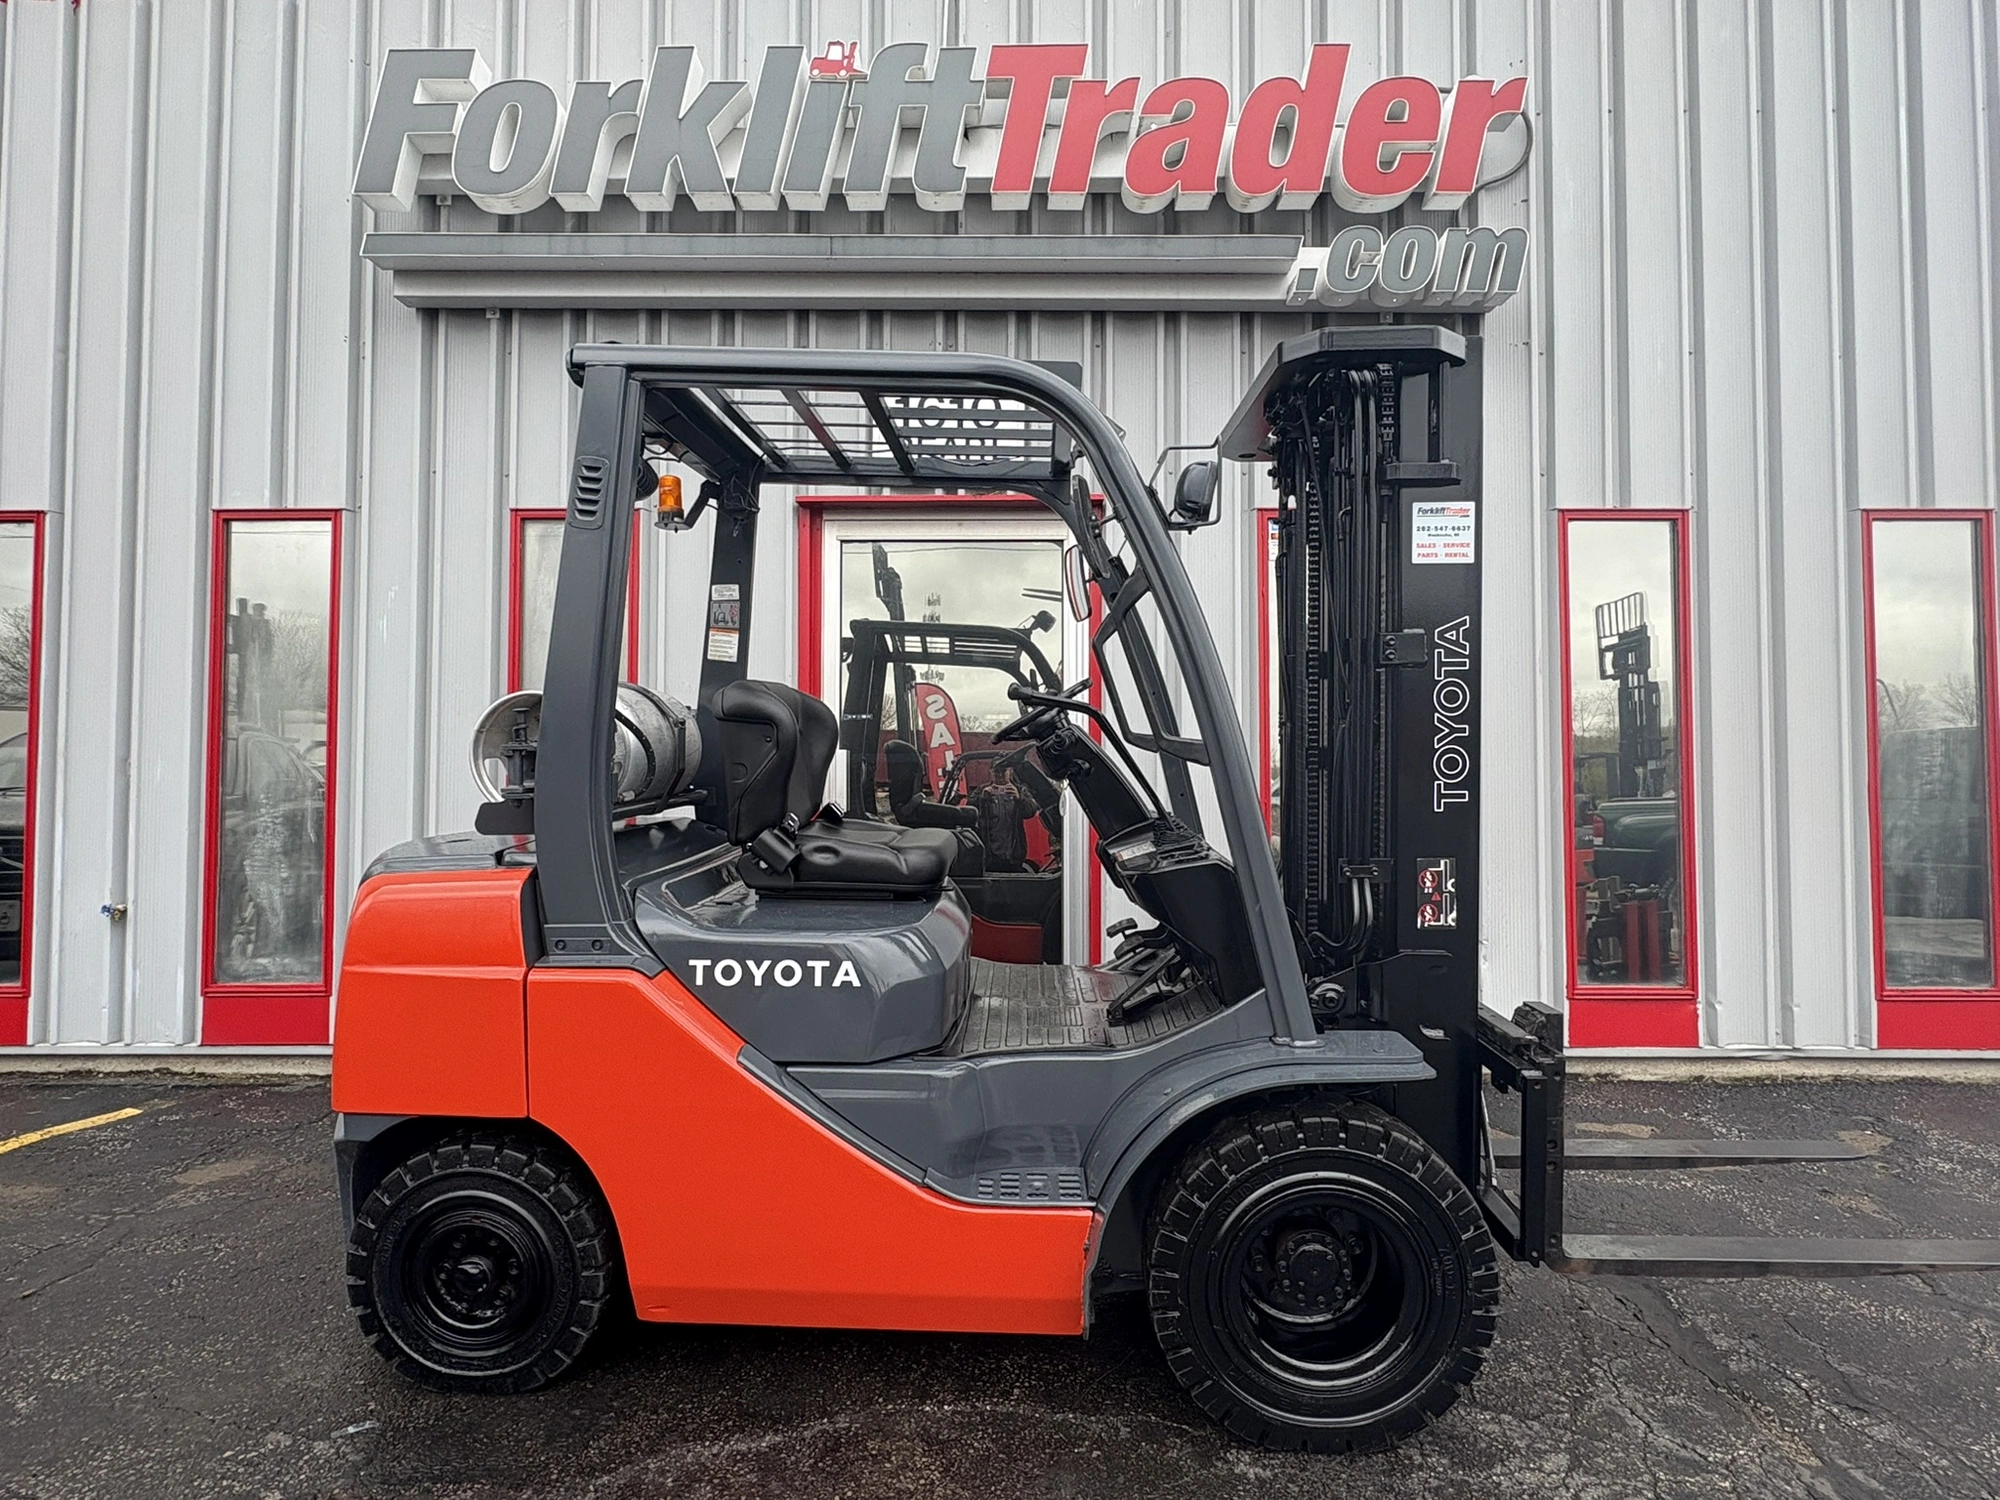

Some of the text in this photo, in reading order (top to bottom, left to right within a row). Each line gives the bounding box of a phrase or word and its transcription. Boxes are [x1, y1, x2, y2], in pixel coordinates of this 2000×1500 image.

[352, 42, 1530, 203] ForkliftTrader
[1292, 224, 1530, 298] .com
[1417, 506, 1471, 515] ForkliftTrader
[1433, 615, 1470, 812] TOYOTA
[688, 958, 861, 987] TOYOTA
